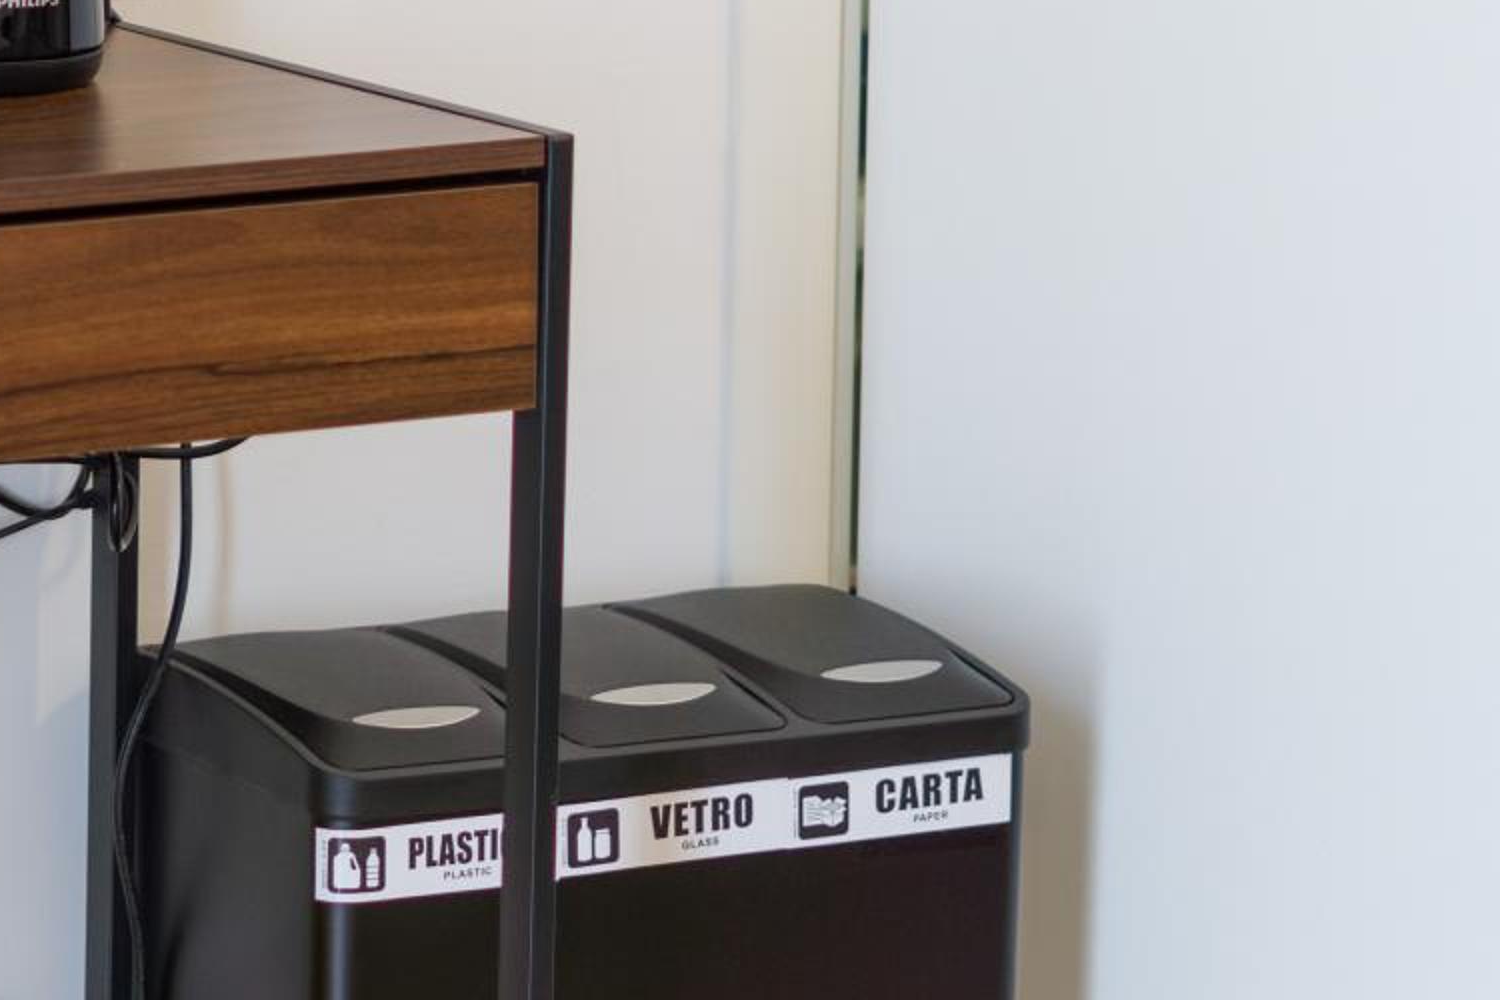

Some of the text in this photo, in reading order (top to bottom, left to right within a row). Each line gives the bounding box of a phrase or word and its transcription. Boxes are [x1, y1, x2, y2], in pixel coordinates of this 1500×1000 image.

[875, 768, 983, 813] CARTA
[650, 793, 753, 840] VETRO
[913, 810, 949, 823] PAPER
[408, 828, 503, 870] PLASTI
[681, 836, 720, 851] GLASS
[443, 866, 493, 880] PLASTIC
